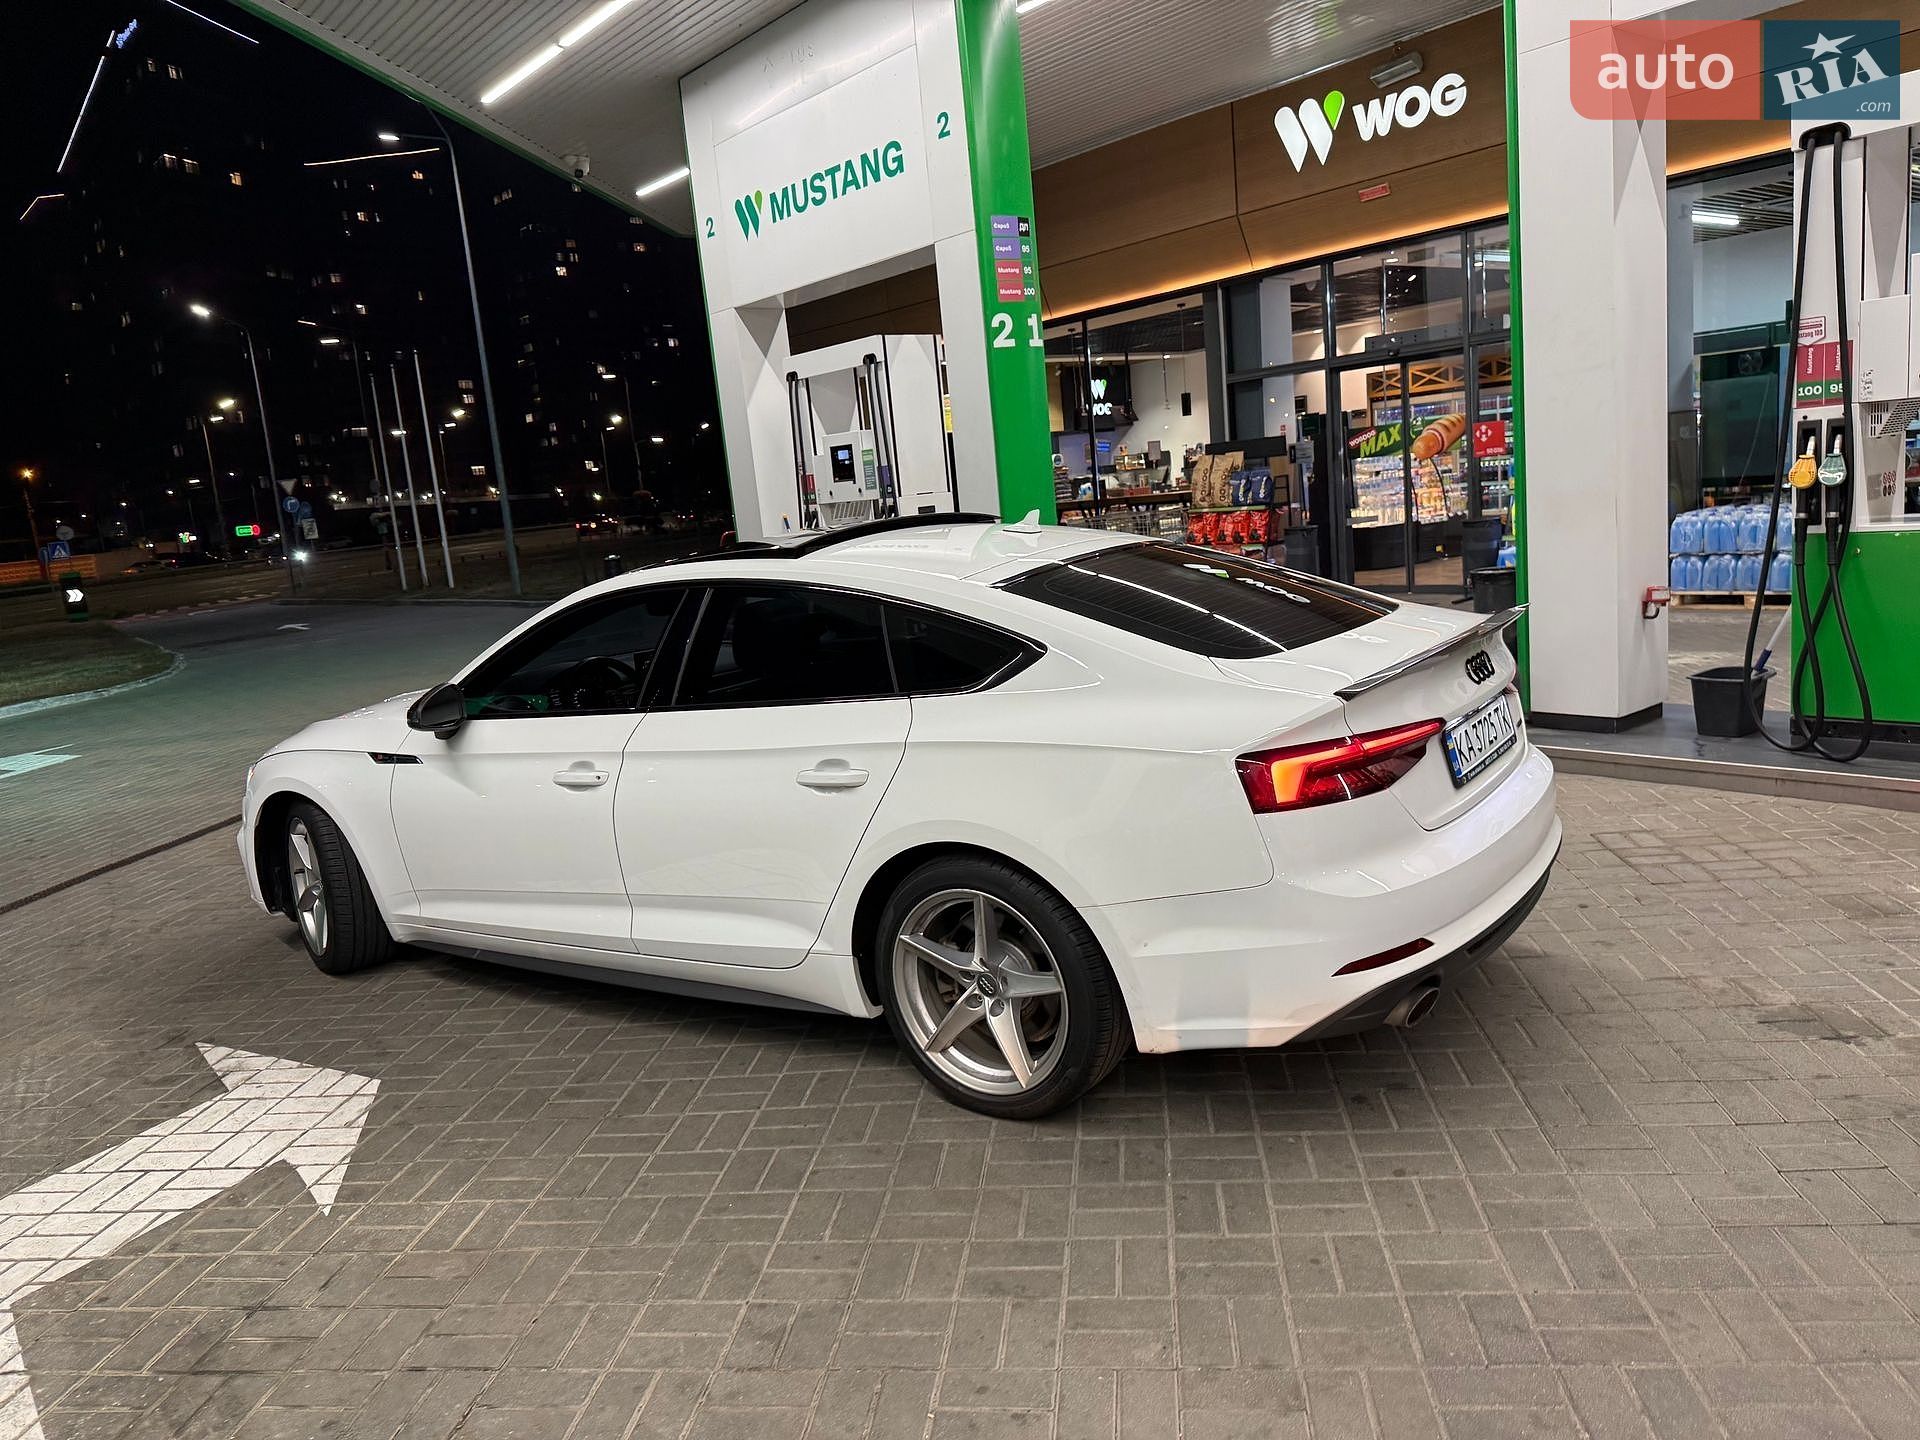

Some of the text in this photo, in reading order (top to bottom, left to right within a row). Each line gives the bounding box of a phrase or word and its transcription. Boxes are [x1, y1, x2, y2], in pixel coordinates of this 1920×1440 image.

[1352, 73, 1467, 142] WOG
[936, 111, 951, 139] 2
[769, 140, 905, 223] MUSTANG
[705, 216, 716, 238] 2
[1023, 266, 1032, 274] 95
[1023, 287, 1036, 296] 100
[991, 313, 1044, 348] 2 1
[1798, 385, 1822, 397] 100
[1360, 423, 1402, 458] MAX
[1454, 729, 1477, 767] KA
[1472, 712, 1497, 752] 3725
[1494, 702, 1511, 735] TK
